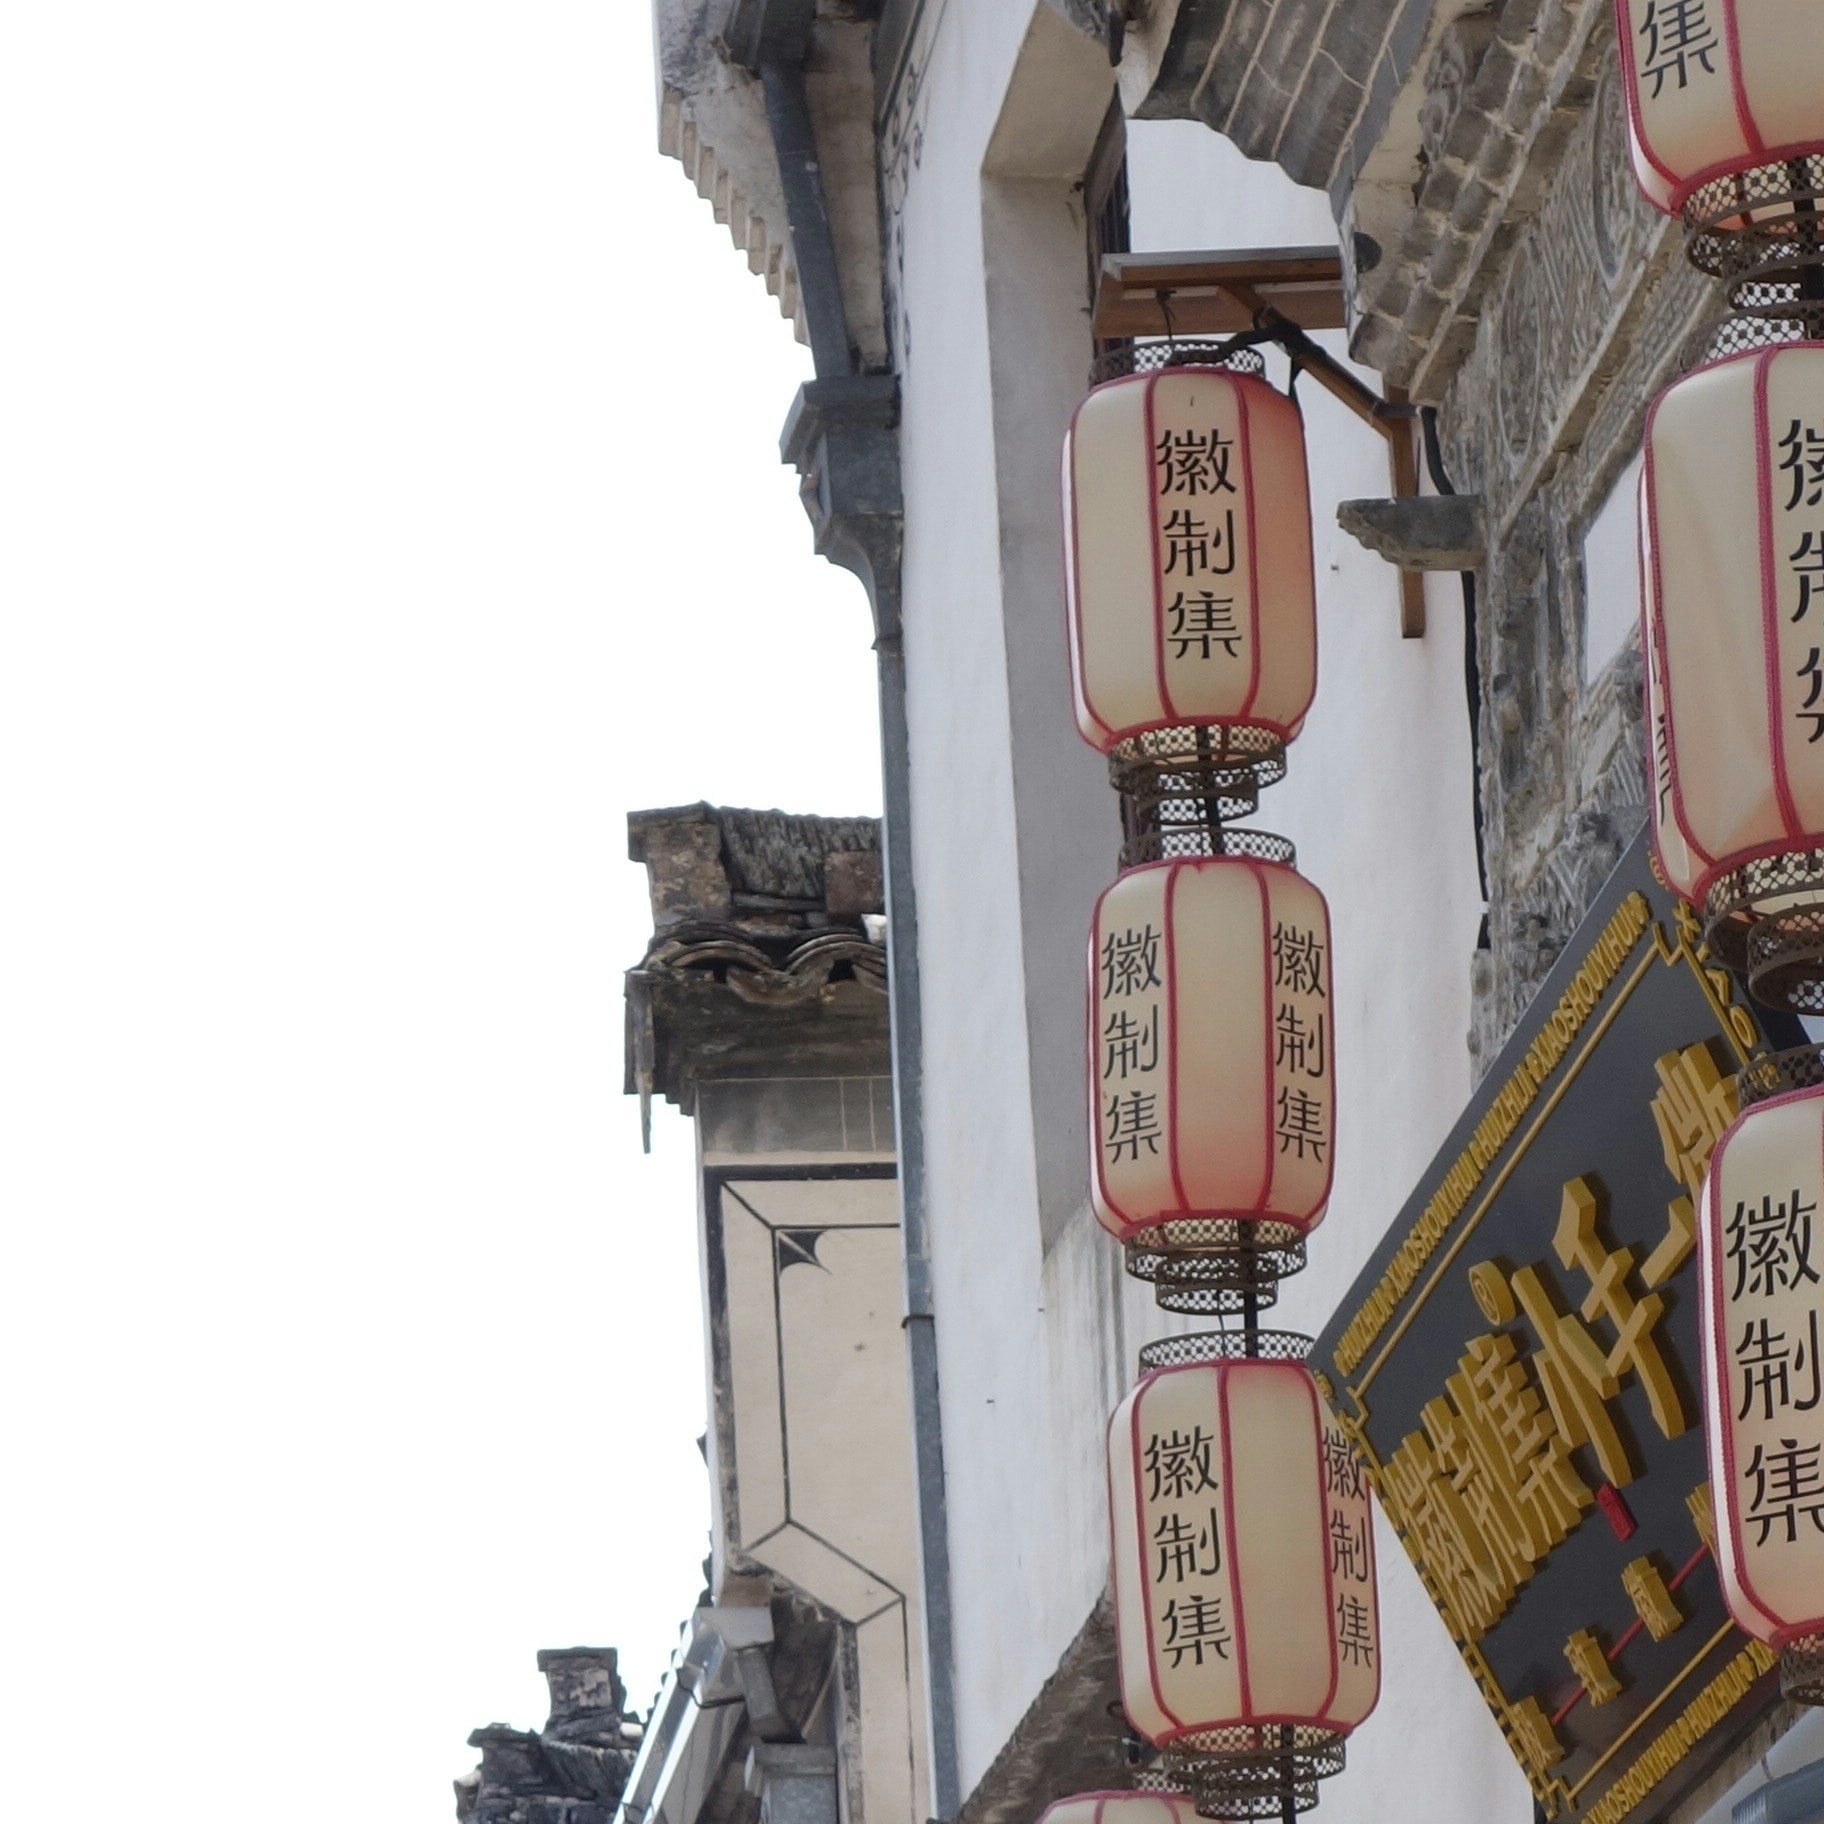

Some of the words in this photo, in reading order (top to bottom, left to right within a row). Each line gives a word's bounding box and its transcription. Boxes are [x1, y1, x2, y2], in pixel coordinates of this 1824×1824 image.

[1155, 426, 1243, 662] 徽制集
[1101, 924, 1162, 1164] 徽制集
[1272, 921, 1327, 1163] 徽制集
[1144, 1425, 1231, 1669] 徽制集
[1321, 1427, 1374, 1669] 徽制集
